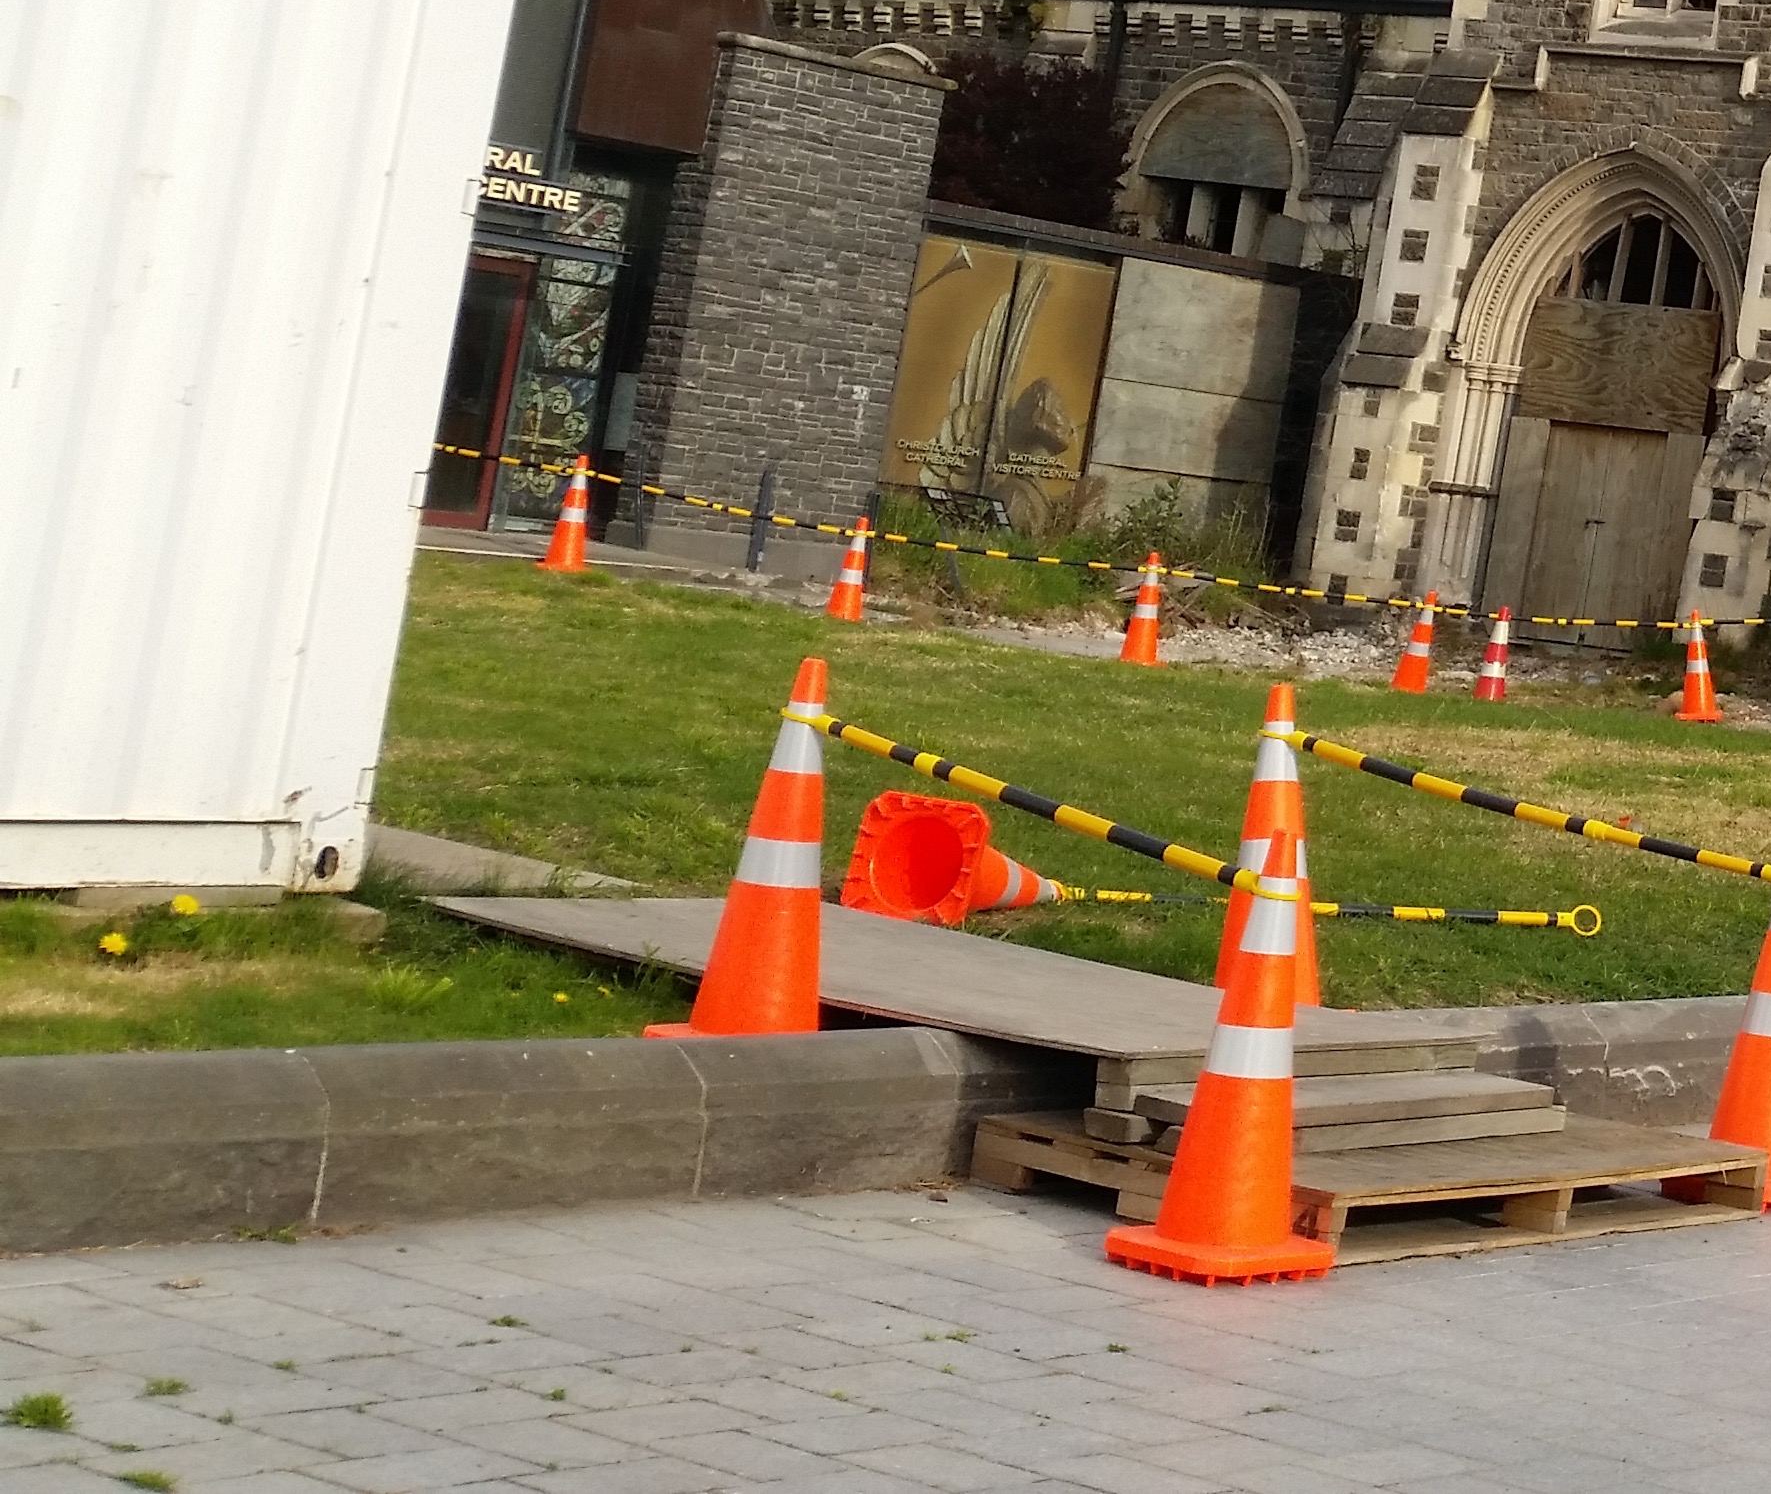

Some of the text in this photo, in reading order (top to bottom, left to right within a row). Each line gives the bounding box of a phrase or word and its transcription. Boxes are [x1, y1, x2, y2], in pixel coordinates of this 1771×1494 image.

[898, 438, 980, 457] CHRISTCHURCH
[906, 452, 966, 468] CATHEDRAL
[1009, 452, 1067, 468] CATHEDRAL
